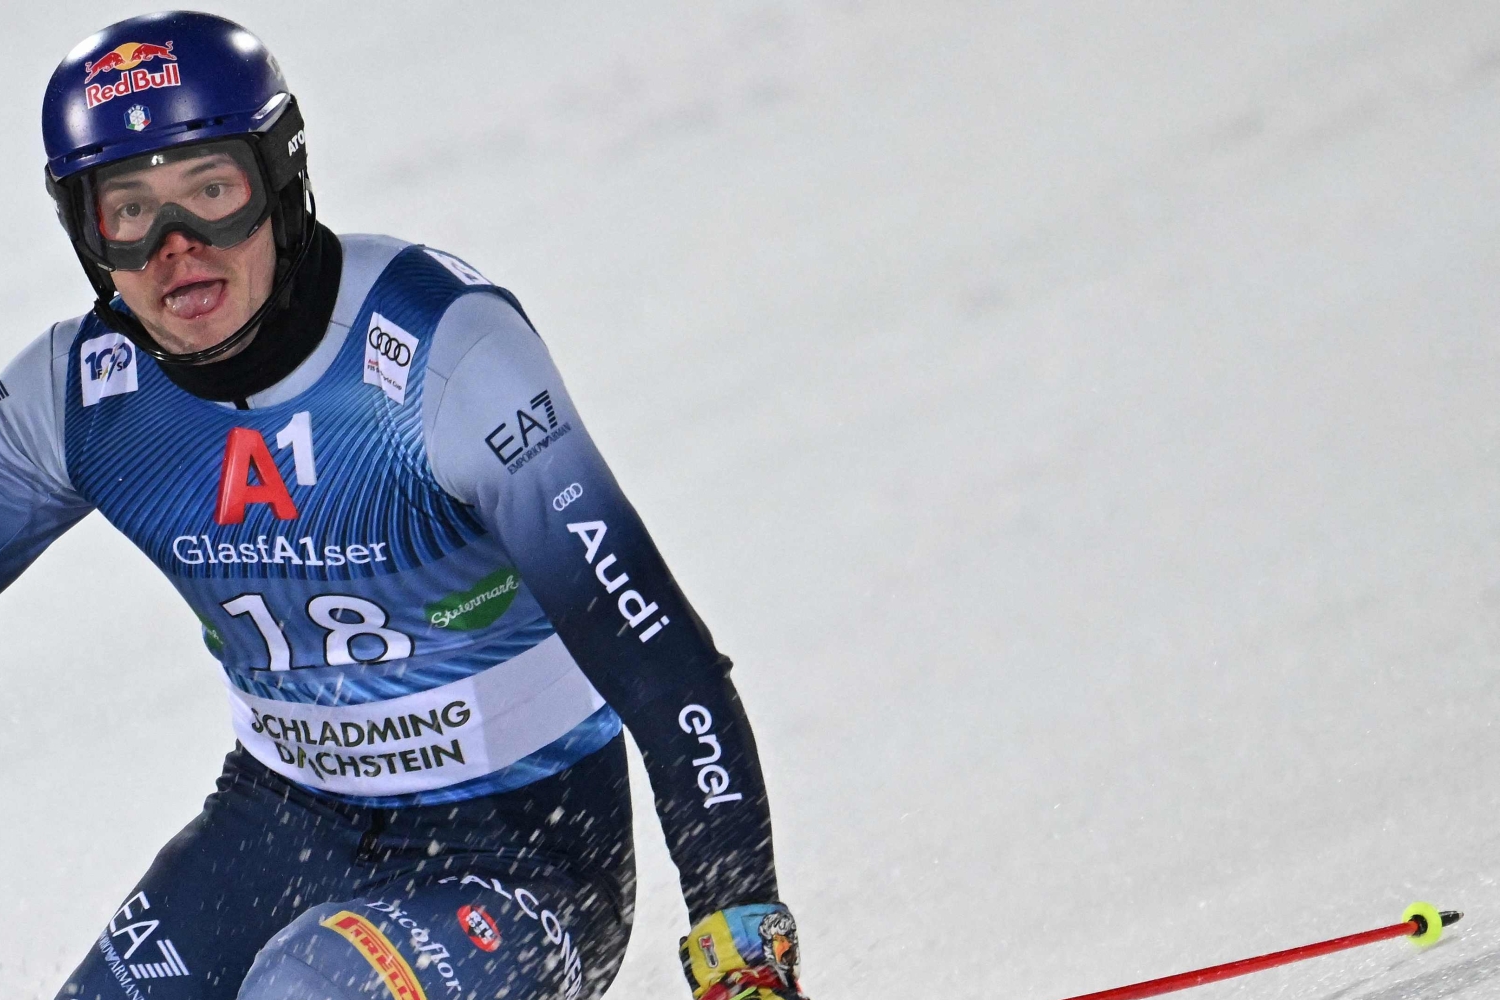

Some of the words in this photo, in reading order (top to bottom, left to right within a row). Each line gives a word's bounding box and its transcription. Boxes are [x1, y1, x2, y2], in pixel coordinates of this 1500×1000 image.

[86, 71, 131, 109] Red
[131, 63, 181, 93] Bull
[213, 410, 317, 525] A1
[484, 389, 558, 466] EA7
[430, 574, 519, 629] Steiermark
[566, 519, 671, 644] Audi
[222, 592, 415, 672] 18
[251, 699, 472, 749] SCHLADMING
[678, 703, 743, 809] enel
[109, 890, 191, 980] EA7
